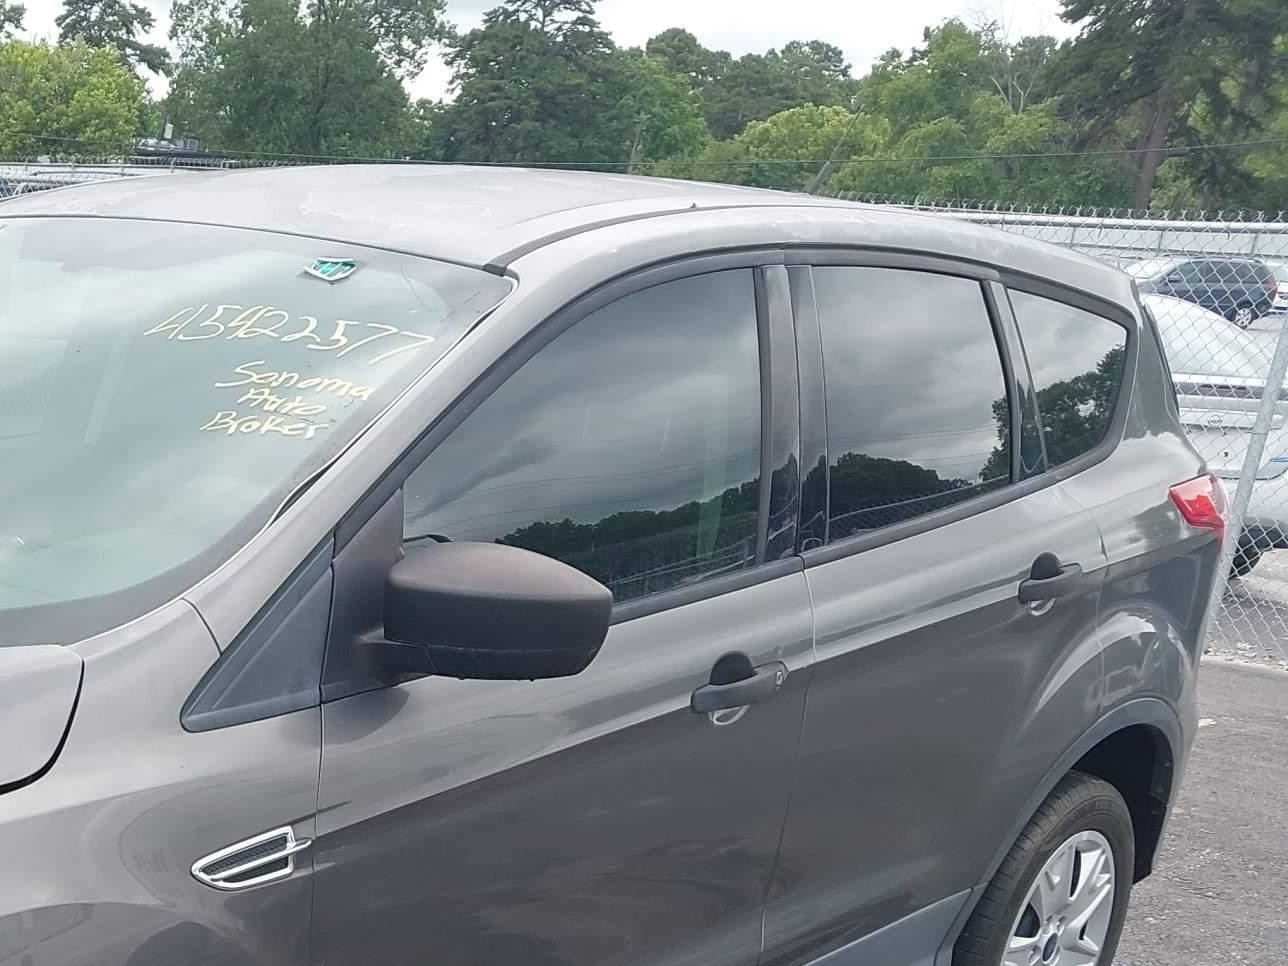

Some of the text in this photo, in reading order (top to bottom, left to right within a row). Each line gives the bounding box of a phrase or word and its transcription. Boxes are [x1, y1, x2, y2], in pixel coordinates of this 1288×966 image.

[144, 304, 436, 365] 45422577
[215, 361, 376, 401] Sonoma
[236, 387, 327, 416] Auto
[200, 410, 329, 440] Broker
